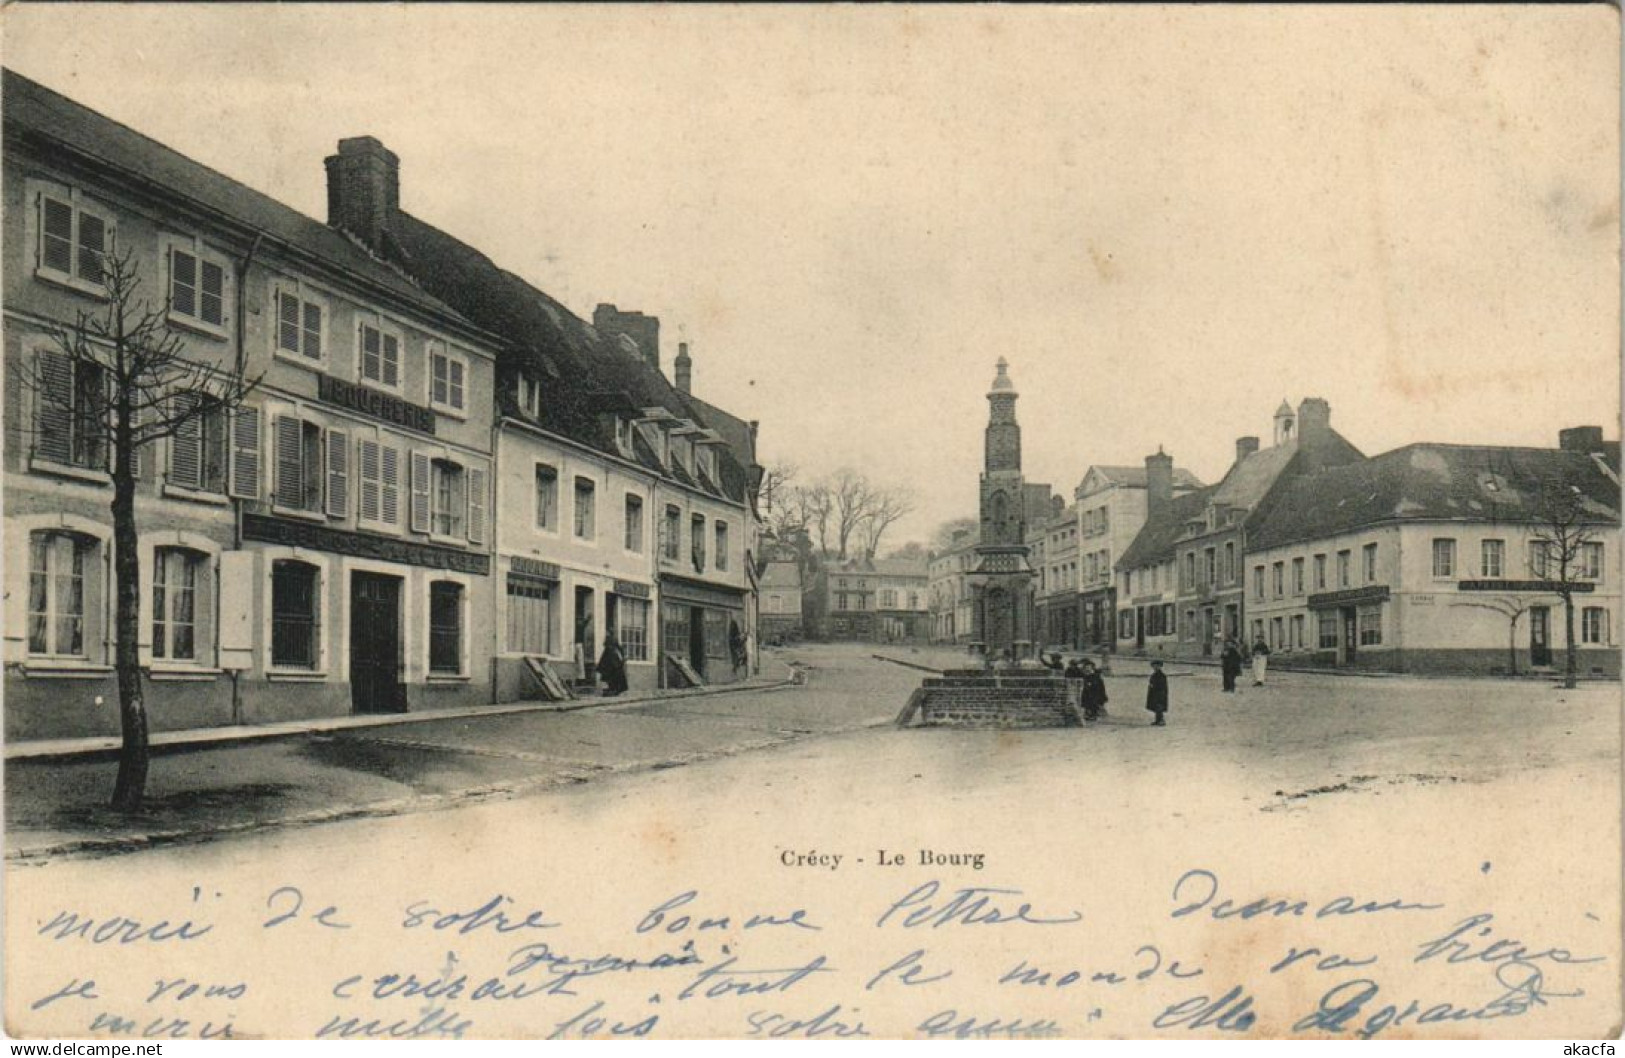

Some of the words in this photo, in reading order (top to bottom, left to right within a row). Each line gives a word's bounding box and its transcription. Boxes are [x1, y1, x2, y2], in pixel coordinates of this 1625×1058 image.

[780, 849, 843, 869] Crécy
[877, 850, 905, 867] Le
[918, 849, 986, 870] Bourg
